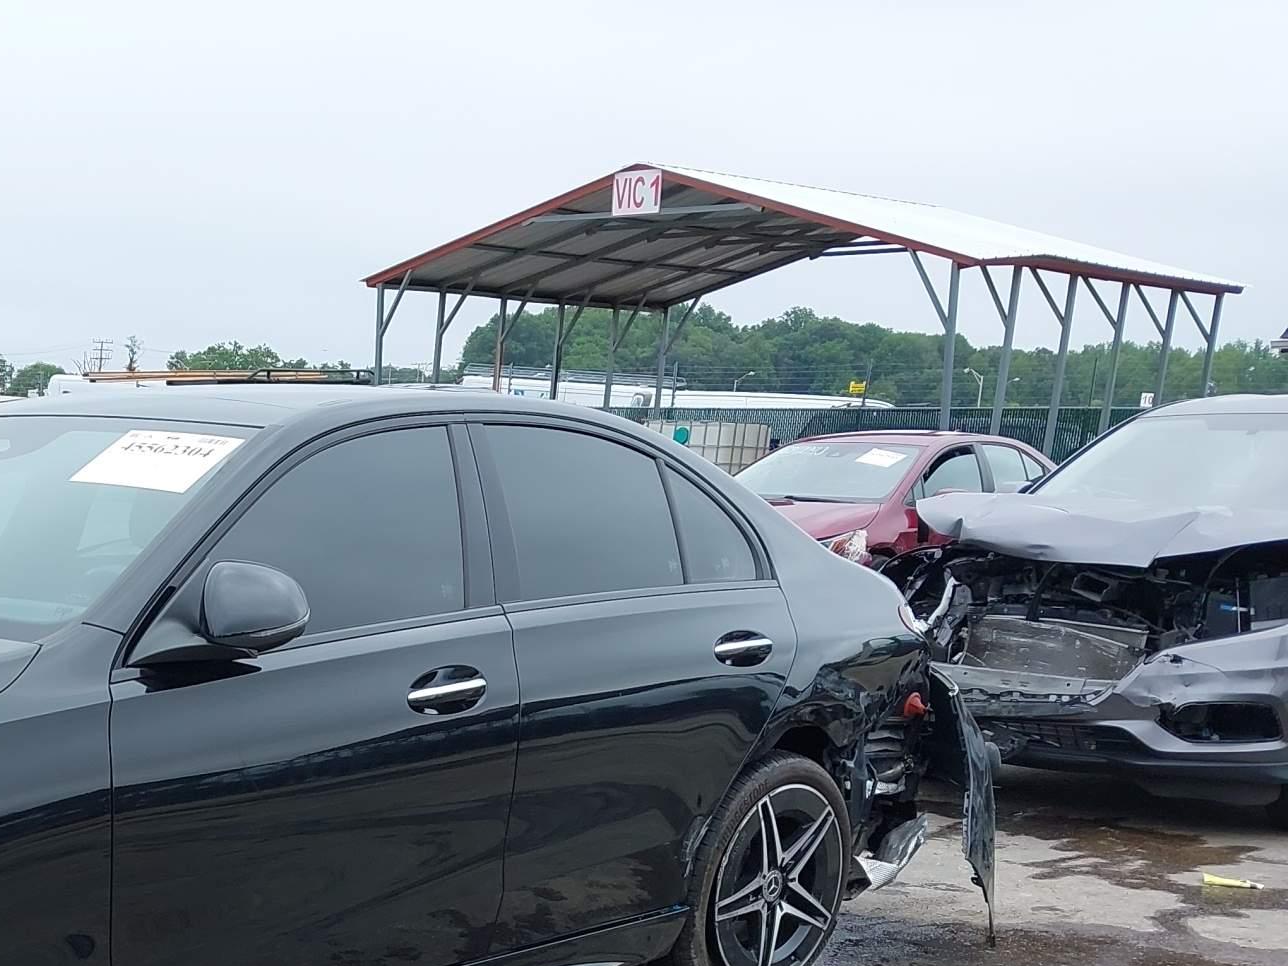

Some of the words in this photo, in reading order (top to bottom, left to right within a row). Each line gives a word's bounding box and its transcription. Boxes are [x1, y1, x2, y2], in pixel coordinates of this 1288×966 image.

[616, 176, 645, 209] VIC
[650, 175, 660, 207] 1
[121, 442, 214, 457] 45562304
